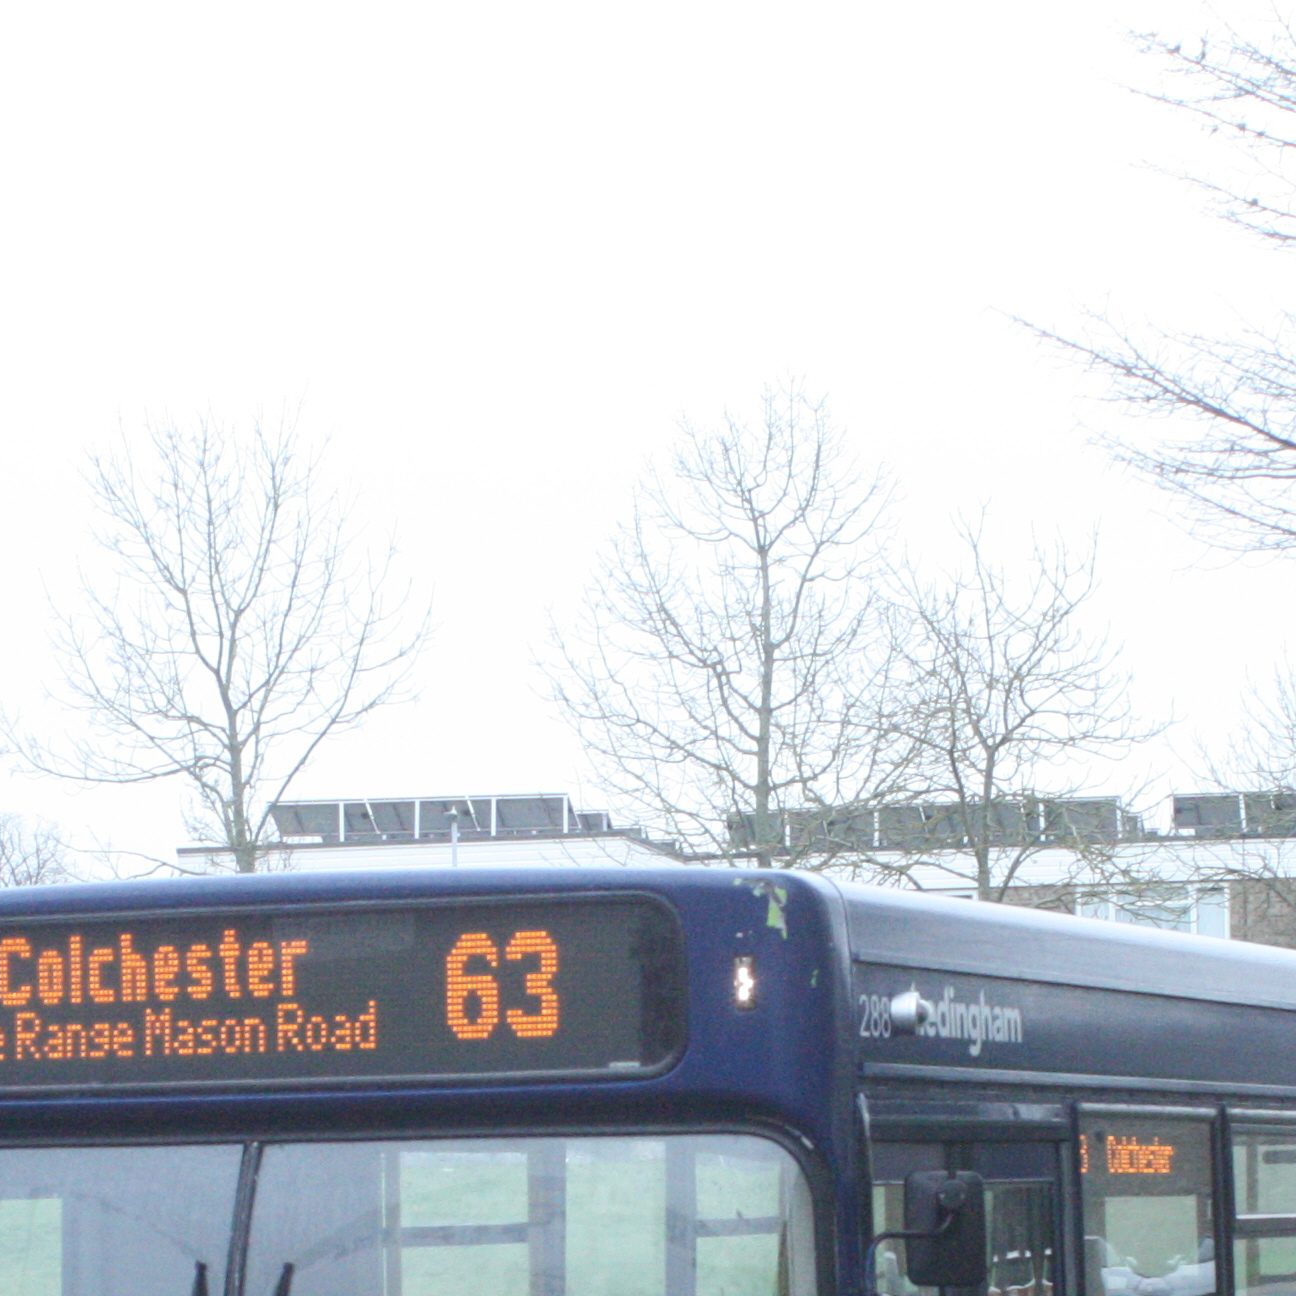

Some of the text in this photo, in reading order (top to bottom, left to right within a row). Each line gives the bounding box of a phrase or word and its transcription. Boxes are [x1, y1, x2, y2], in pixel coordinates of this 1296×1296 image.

[446, 931, 559, 1039] 63
[859, 994, 892, 1038] 288
[15, 1011, 134, 1060] Range
[144, 1007, 266, 1056] Mason
[276, 999, 377, 1052] Road
[910, 982, 1022, 1057] edingham
